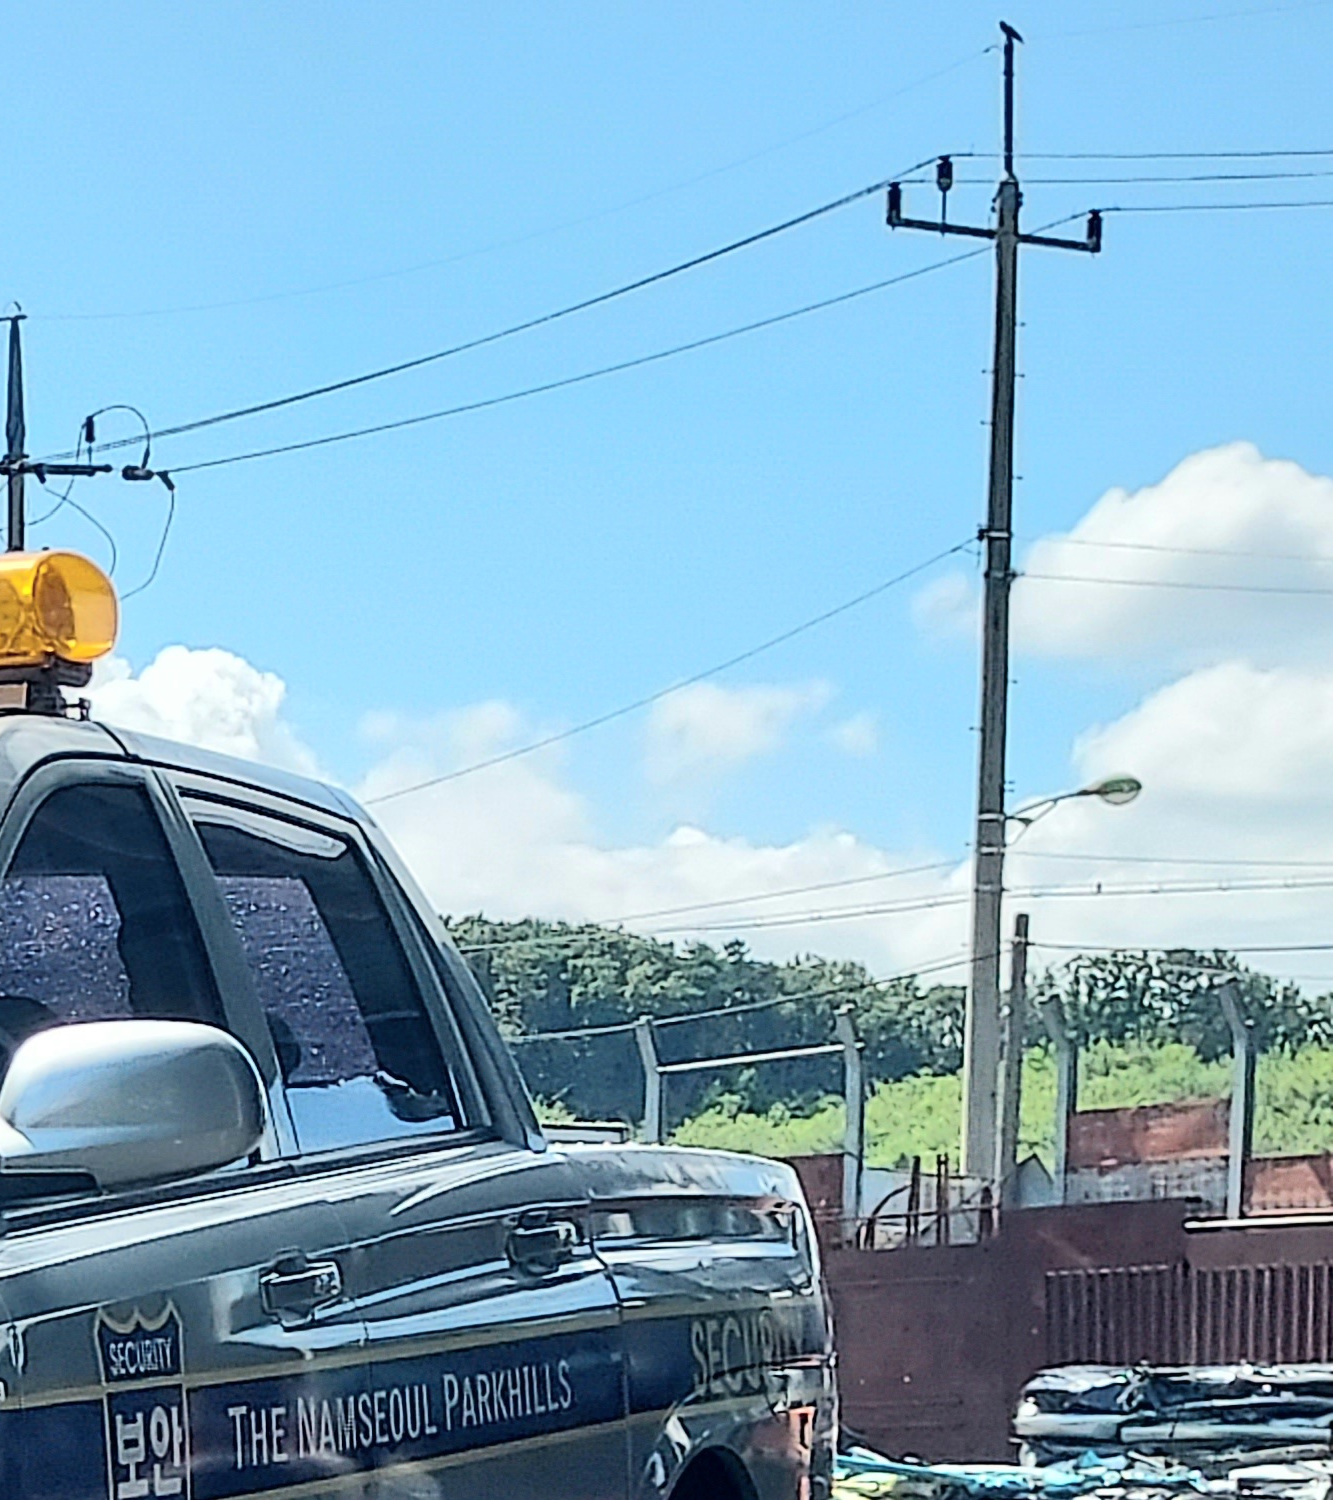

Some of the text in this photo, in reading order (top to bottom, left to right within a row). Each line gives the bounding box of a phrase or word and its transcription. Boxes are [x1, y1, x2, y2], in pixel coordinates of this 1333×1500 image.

[109, 1337, 172, 1374] SECURITY
[115, 1405, 182, 1500] 보안
[228, 1359, 572, 1469] THE NAMSEOUL PARKHILLS
